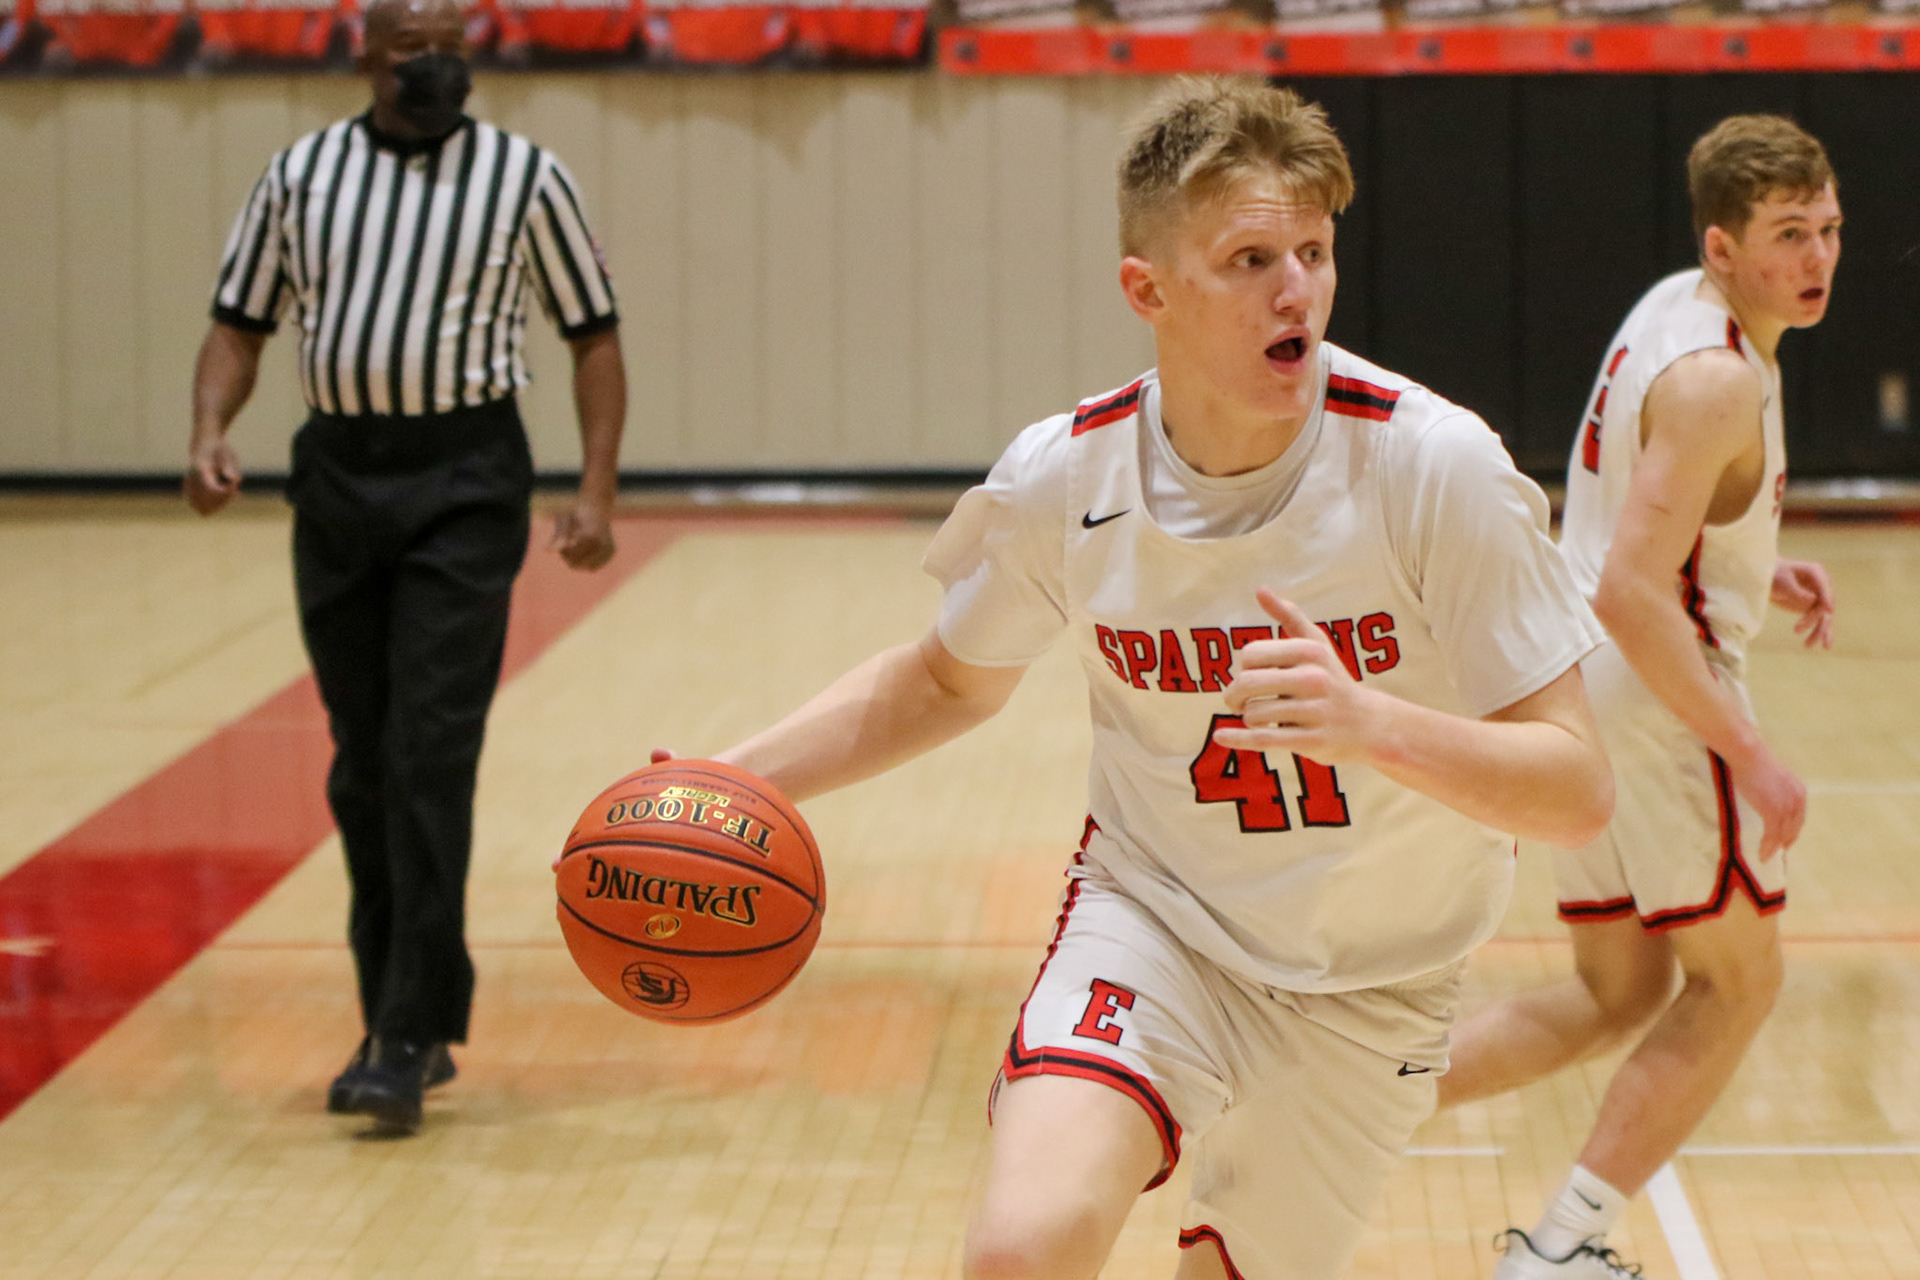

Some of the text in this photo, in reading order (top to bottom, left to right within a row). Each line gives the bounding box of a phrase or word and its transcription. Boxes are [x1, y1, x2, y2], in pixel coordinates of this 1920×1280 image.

[1094, 611, 1400, 693] SPARNS
[659, 786, 731, 808] LEGACY
[1189, 714, 1351, 833] 41
[606, 798, 771, 856] TF-1000
[586, 856, 761, 928] SPALDING
[1071, 977, 1136, 1046] E
